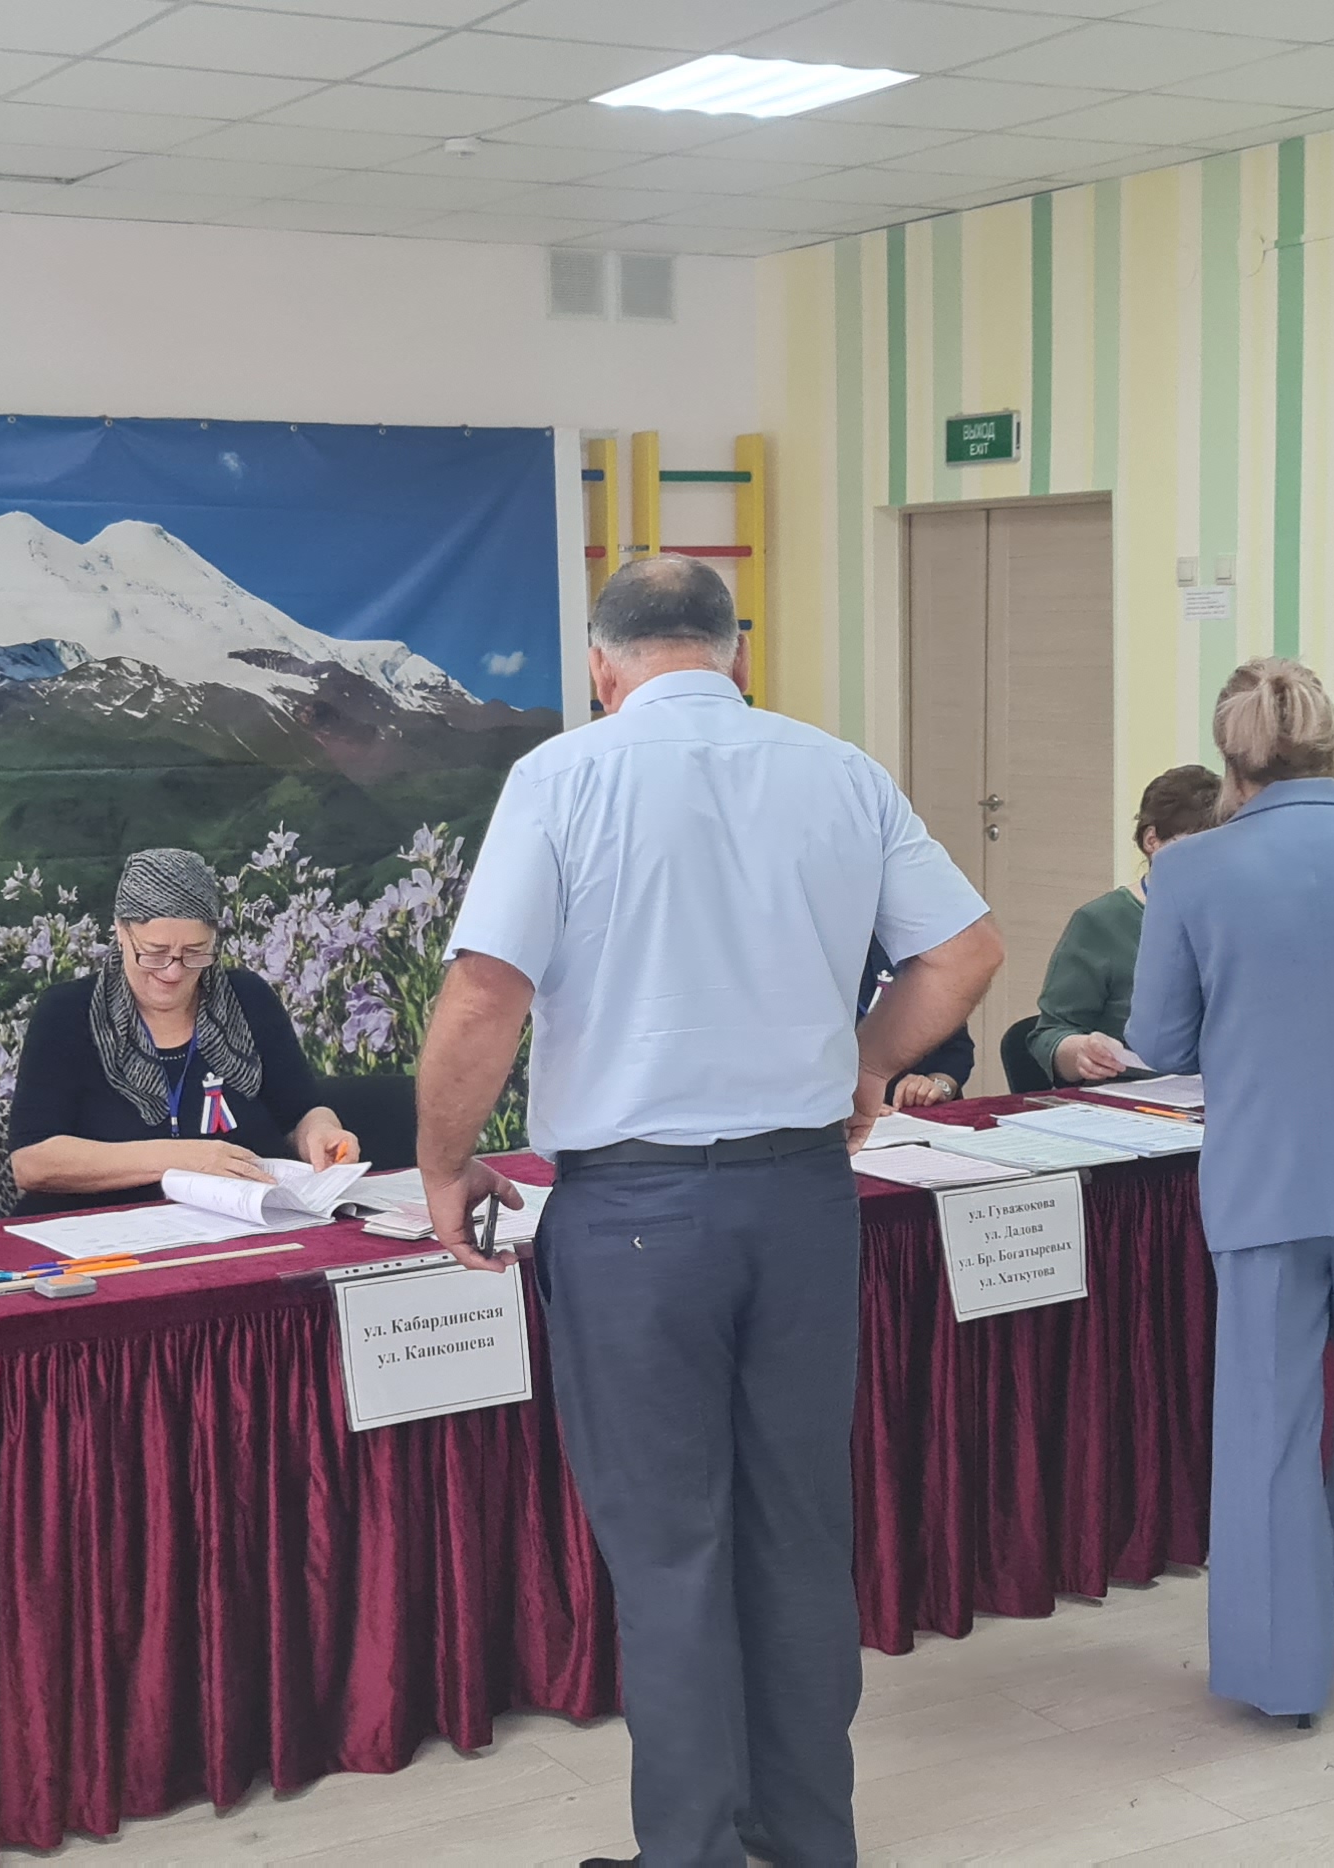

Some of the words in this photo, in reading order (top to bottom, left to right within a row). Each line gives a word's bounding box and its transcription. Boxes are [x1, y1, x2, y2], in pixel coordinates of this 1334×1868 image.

[963, 421, 996, 441] ВЫХОД
[969, 442, 989, 456] EXIT
[968, 1210, 986, 1223] ул.
[988, 1199, 1056, 1219] Гуважокова
[984, 1231, 1002, 1244] ул.
[958, 1259, 975, 1271] ул.
[977, 1253, 996, 1267] Бр.
[999, 1241, 1073, 1262] Богатыревых
[979, 1278, 996, 1291] ул.
[998, 1266, 1056, 1284] Хаткутова
[363, 1324, 387, 1342] ул.
[392, 1306, 504, 1334] Кабардинская
[377, 1352, 401, 1369] ул.
